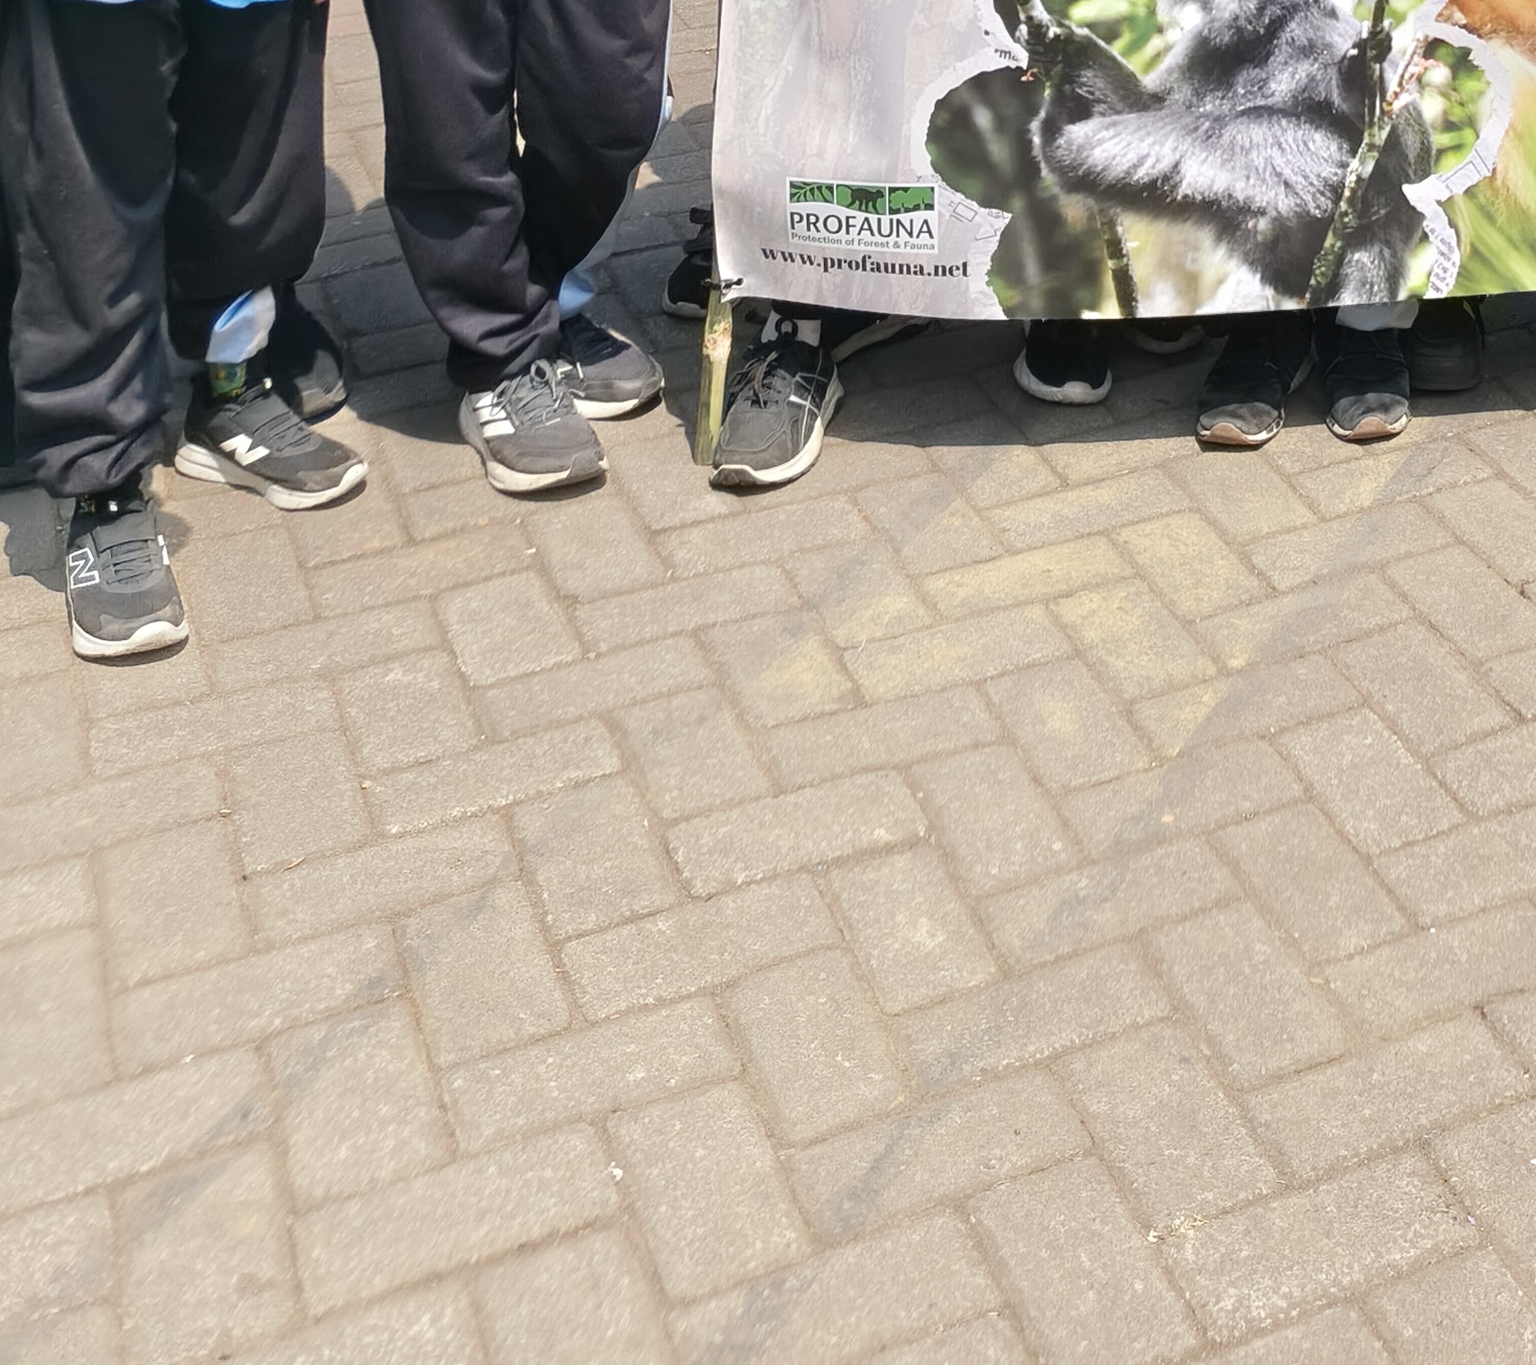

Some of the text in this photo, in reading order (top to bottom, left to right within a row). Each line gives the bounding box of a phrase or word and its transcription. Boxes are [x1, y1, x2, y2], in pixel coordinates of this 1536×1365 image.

[789, 211, 935, 240] PROFAUNA
[791, 232, 935, 251] Protection of Forest & Fauna
[761, 247, 972, 278] www.profauna.net
